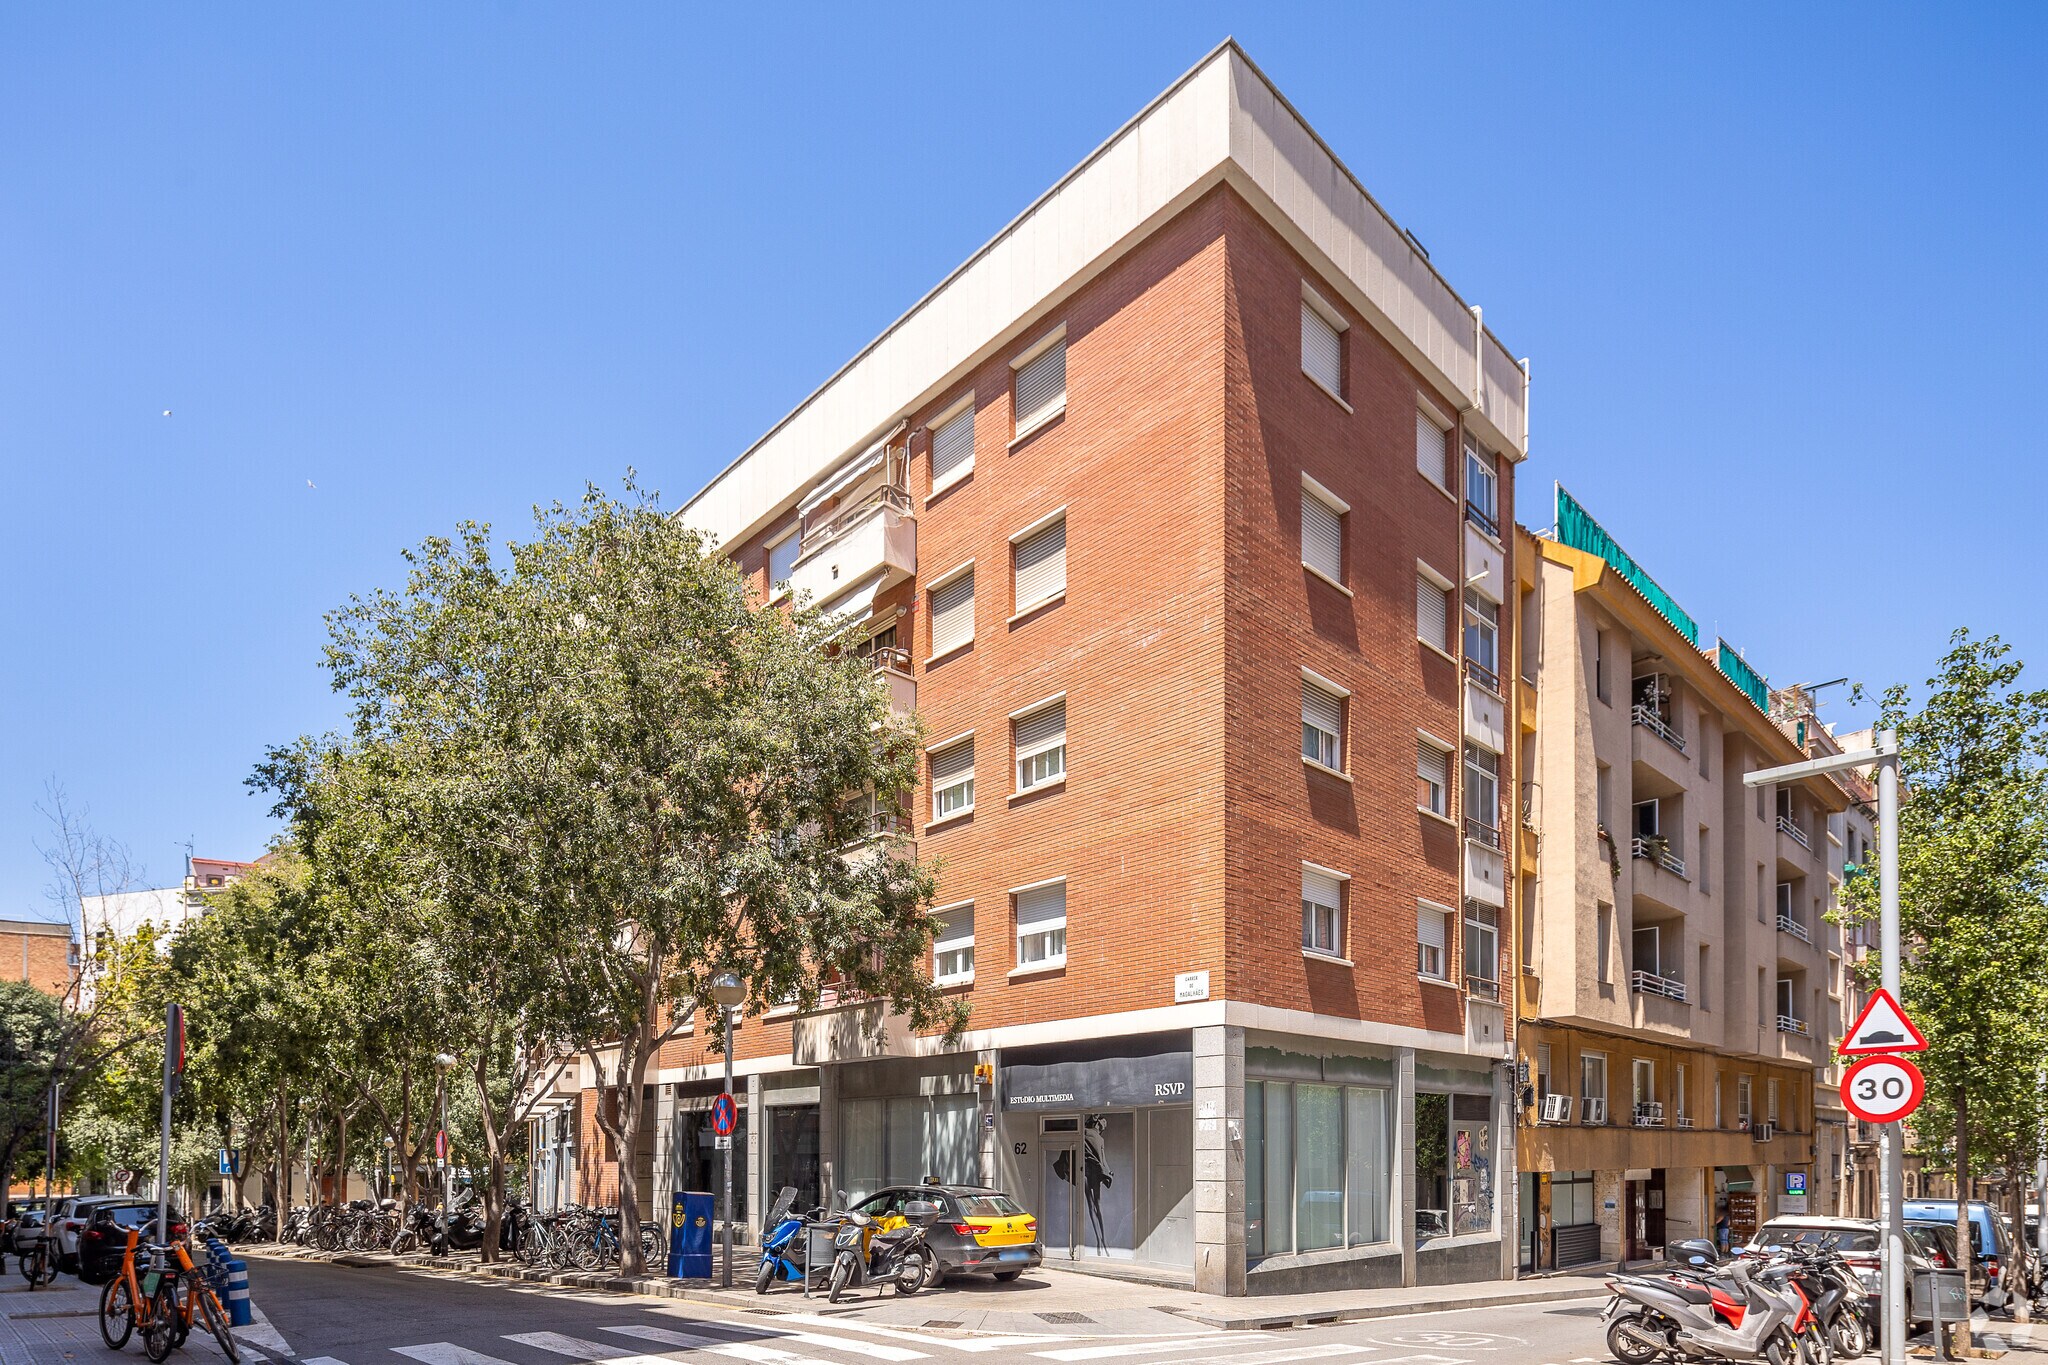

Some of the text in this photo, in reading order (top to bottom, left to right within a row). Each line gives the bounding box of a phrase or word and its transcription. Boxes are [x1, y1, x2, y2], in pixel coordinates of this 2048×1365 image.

[1154, 1082, 1185, 1096] RSVP
[1857, 1077, 1904, 1101] 30
[1010, 1093, 1074, 1104] ESTUDIO MULTIMEDIA
[1014, 1142, 1027, 1155] 62
[1392, 1333, 1494, 1347] 30
